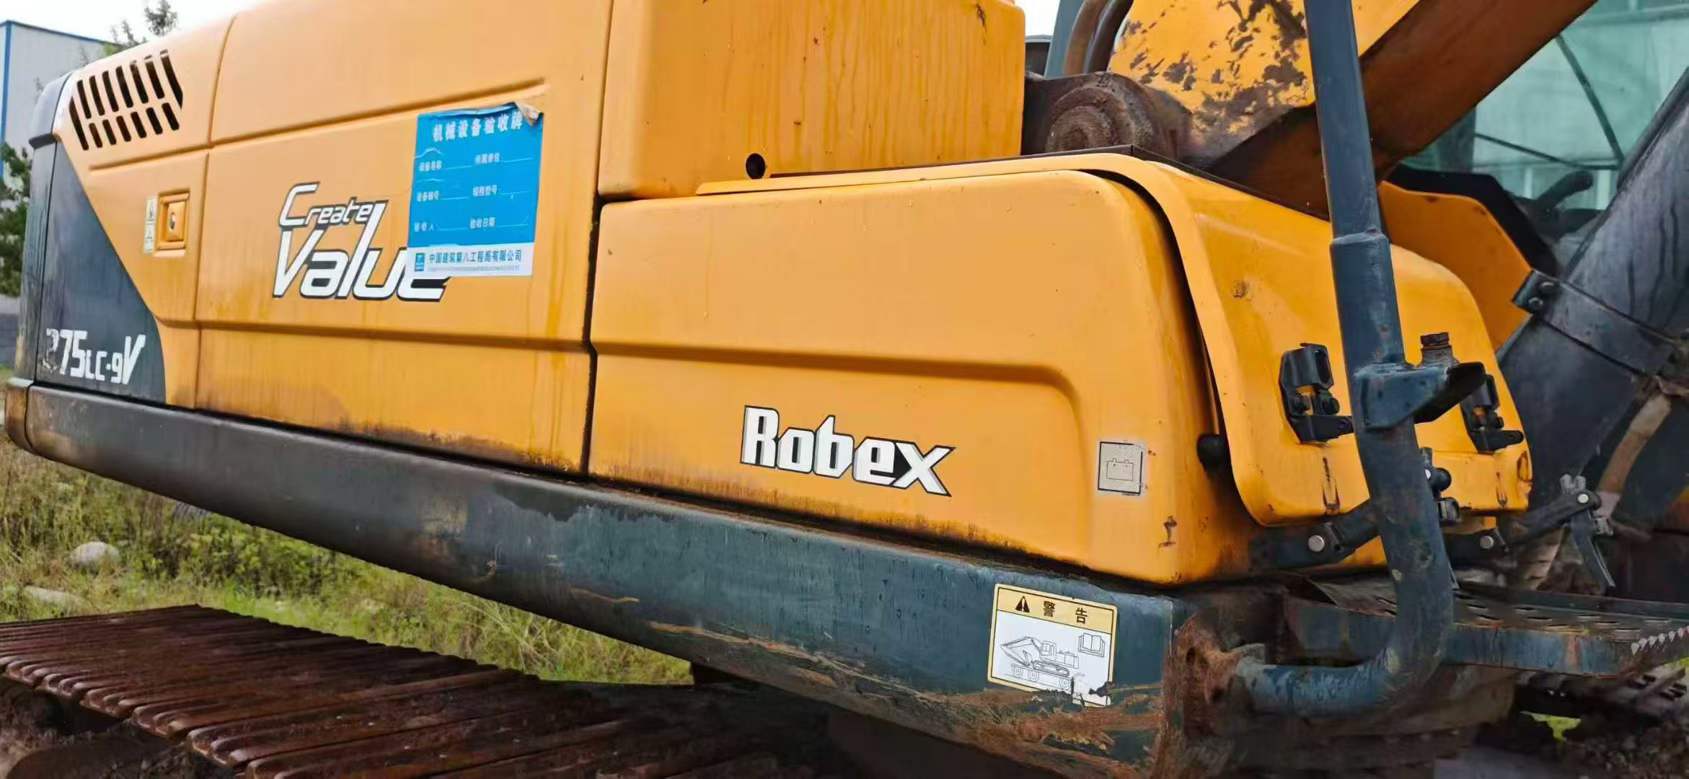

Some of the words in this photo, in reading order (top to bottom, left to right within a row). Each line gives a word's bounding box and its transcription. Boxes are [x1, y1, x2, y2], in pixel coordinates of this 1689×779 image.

[279, 181, 374, 227] Create
[740, 405, 956, 497] Robex
[1042, 600, 1088, 625] 警告
